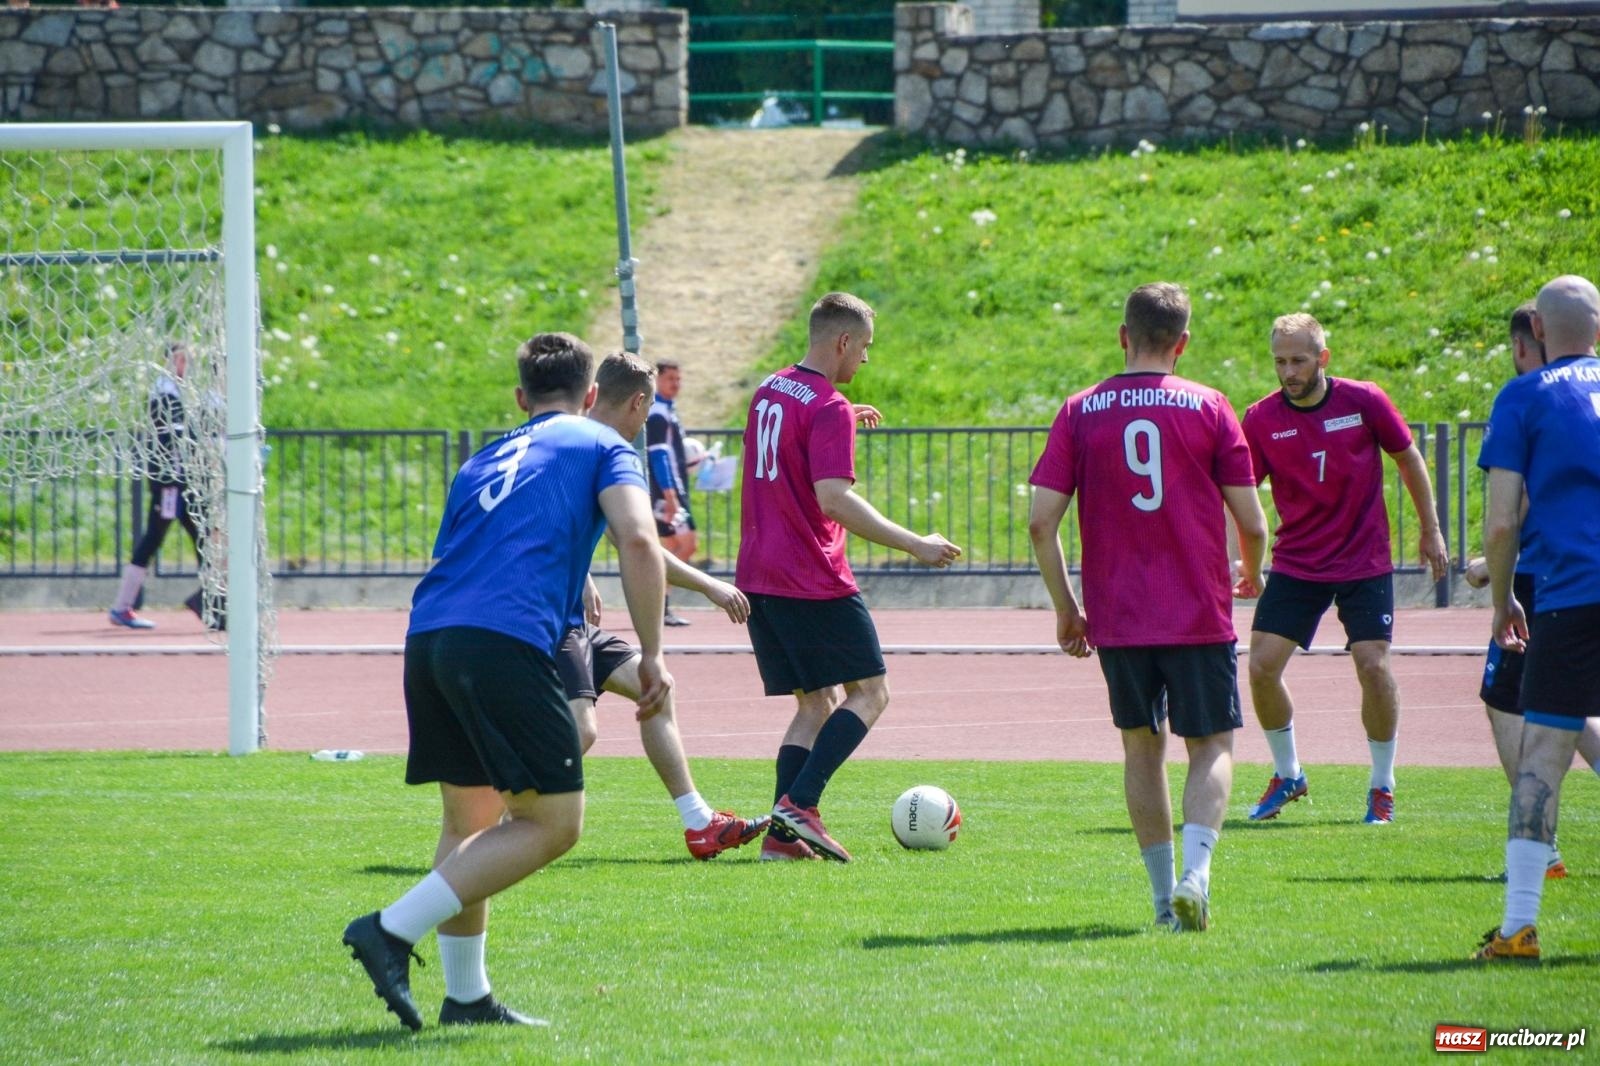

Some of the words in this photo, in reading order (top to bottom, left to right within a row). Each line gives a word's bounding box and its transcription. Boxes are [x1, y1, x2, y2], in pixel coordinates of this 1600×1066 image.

[771, 376, 817, 405] CHORZÓW
[1082, 390, 1117, 414] KMP
[1120, 387, 1203, 411] CHORZÓW
[755, 398, 783, 482] 10
[1124, 419, 1163, 512] 9
[1312, 450, 1326, 482] 7
[479, 434, 532, 512] 3
